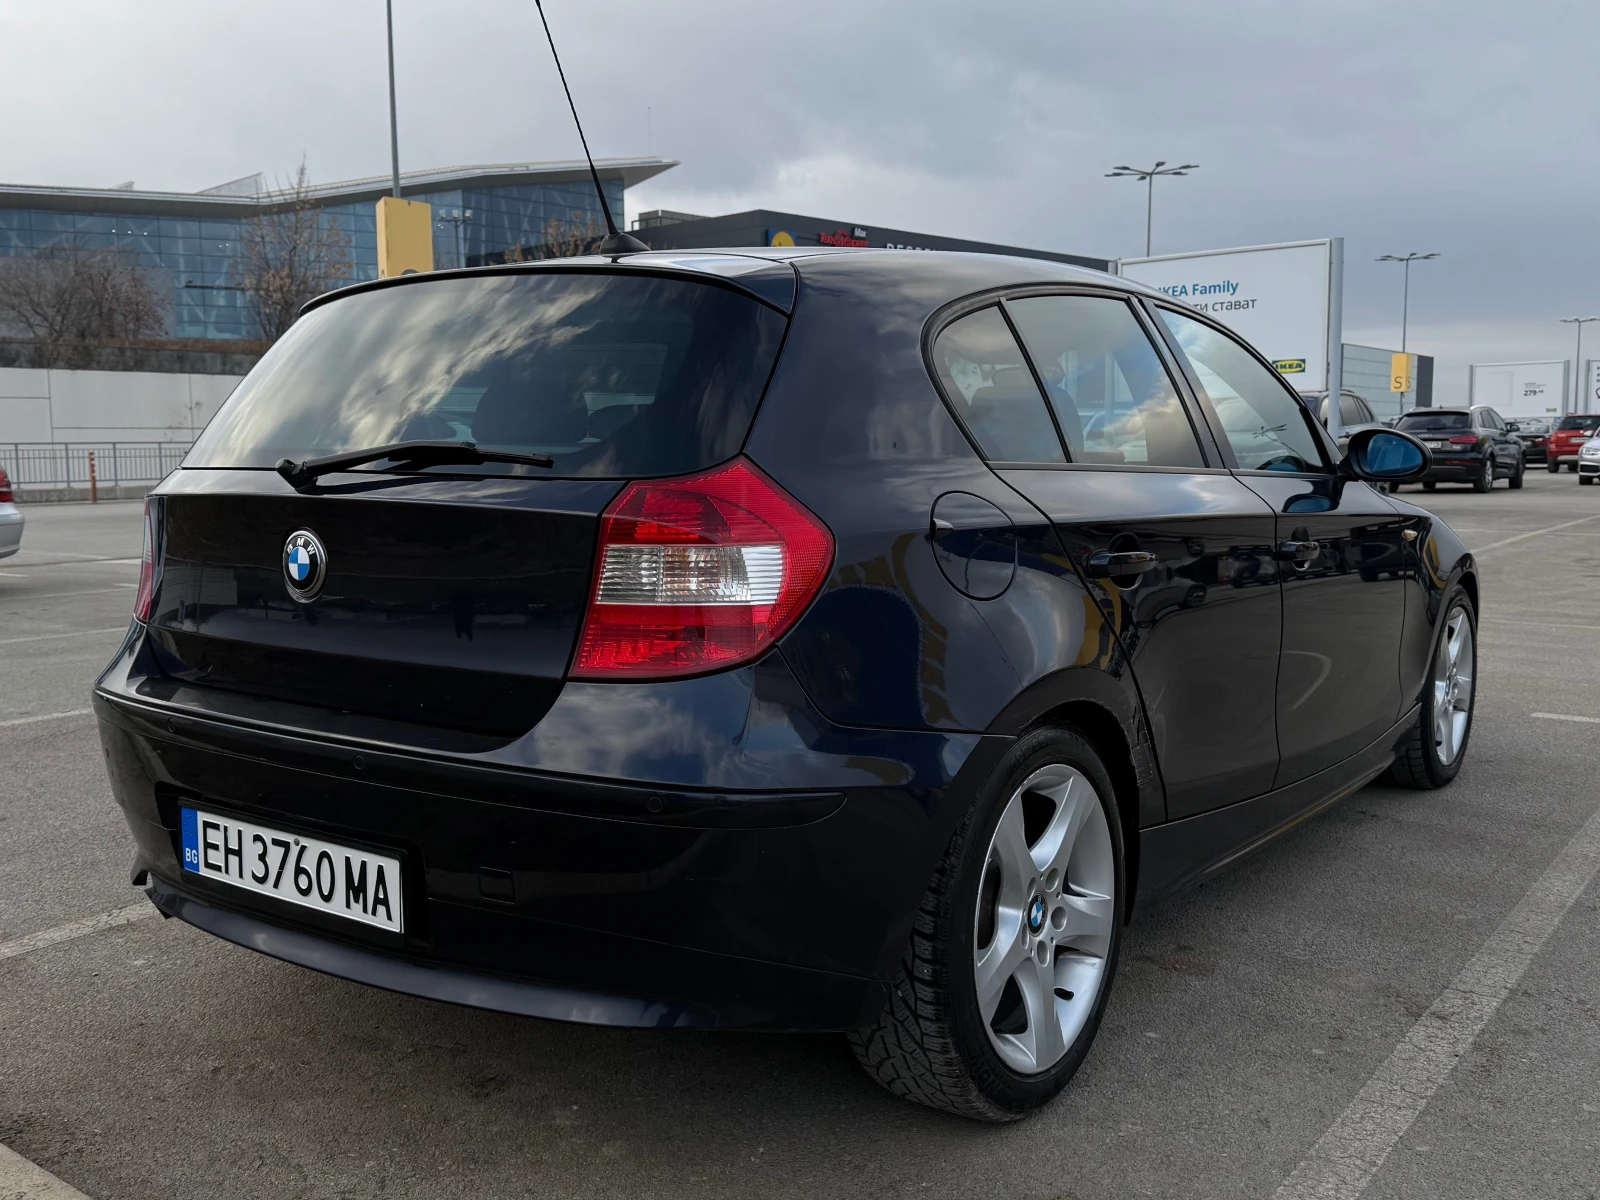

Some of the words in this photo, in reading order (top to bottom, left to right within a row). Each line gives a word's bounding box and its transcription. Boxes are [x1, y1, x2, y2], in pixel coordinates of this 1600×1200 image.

[1192, 280, 1239, 296] Family
[1212, 299, 1257, 312] стават
[1275, 362, 1302, 370] IKEA
[287, 537, 316, 556] BMW
[185, 847, 198, 864] BG
